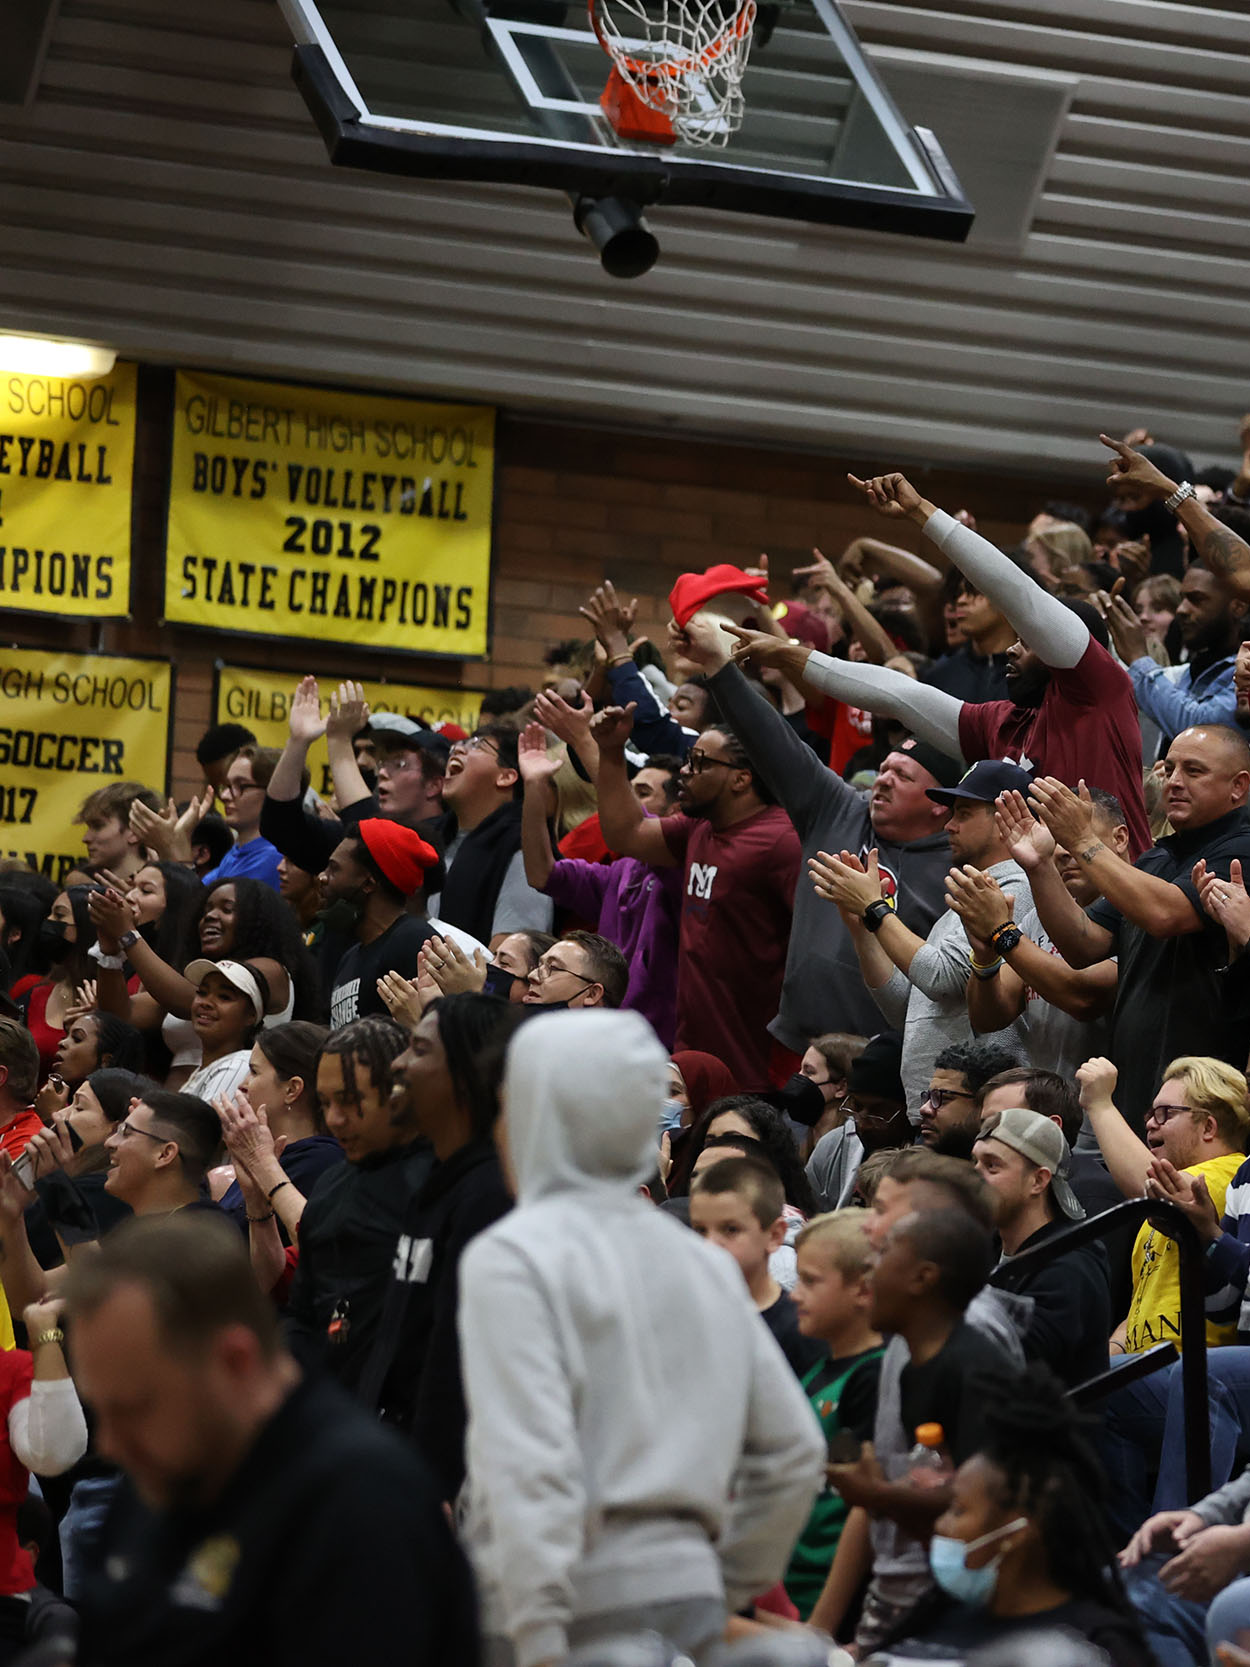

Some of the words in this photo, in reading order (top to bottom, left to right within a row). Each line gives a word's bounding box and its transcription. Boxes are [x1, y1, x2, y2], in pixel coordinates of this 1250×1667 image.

[8, 377, 119, 426] SCHOOL
[185, 395, 295, 446] GILBERT
[304, 413, 366, 455] HIGH
[375, 421, 478, 468] SCHOOL
[193, 452, 278, 500] BOYS'
[288, 463, 468, 522] VOLLEYBALL
[283, 516, 382, 562] 2012
[0, 546, 113, 599] PIONS
[181, 556, 278, 610] STATE
[288, 568, 473, 631] CHAMPIONS
[52, 672, 162, 712] SCHOOL
[0, 784, 38, 824] 17
